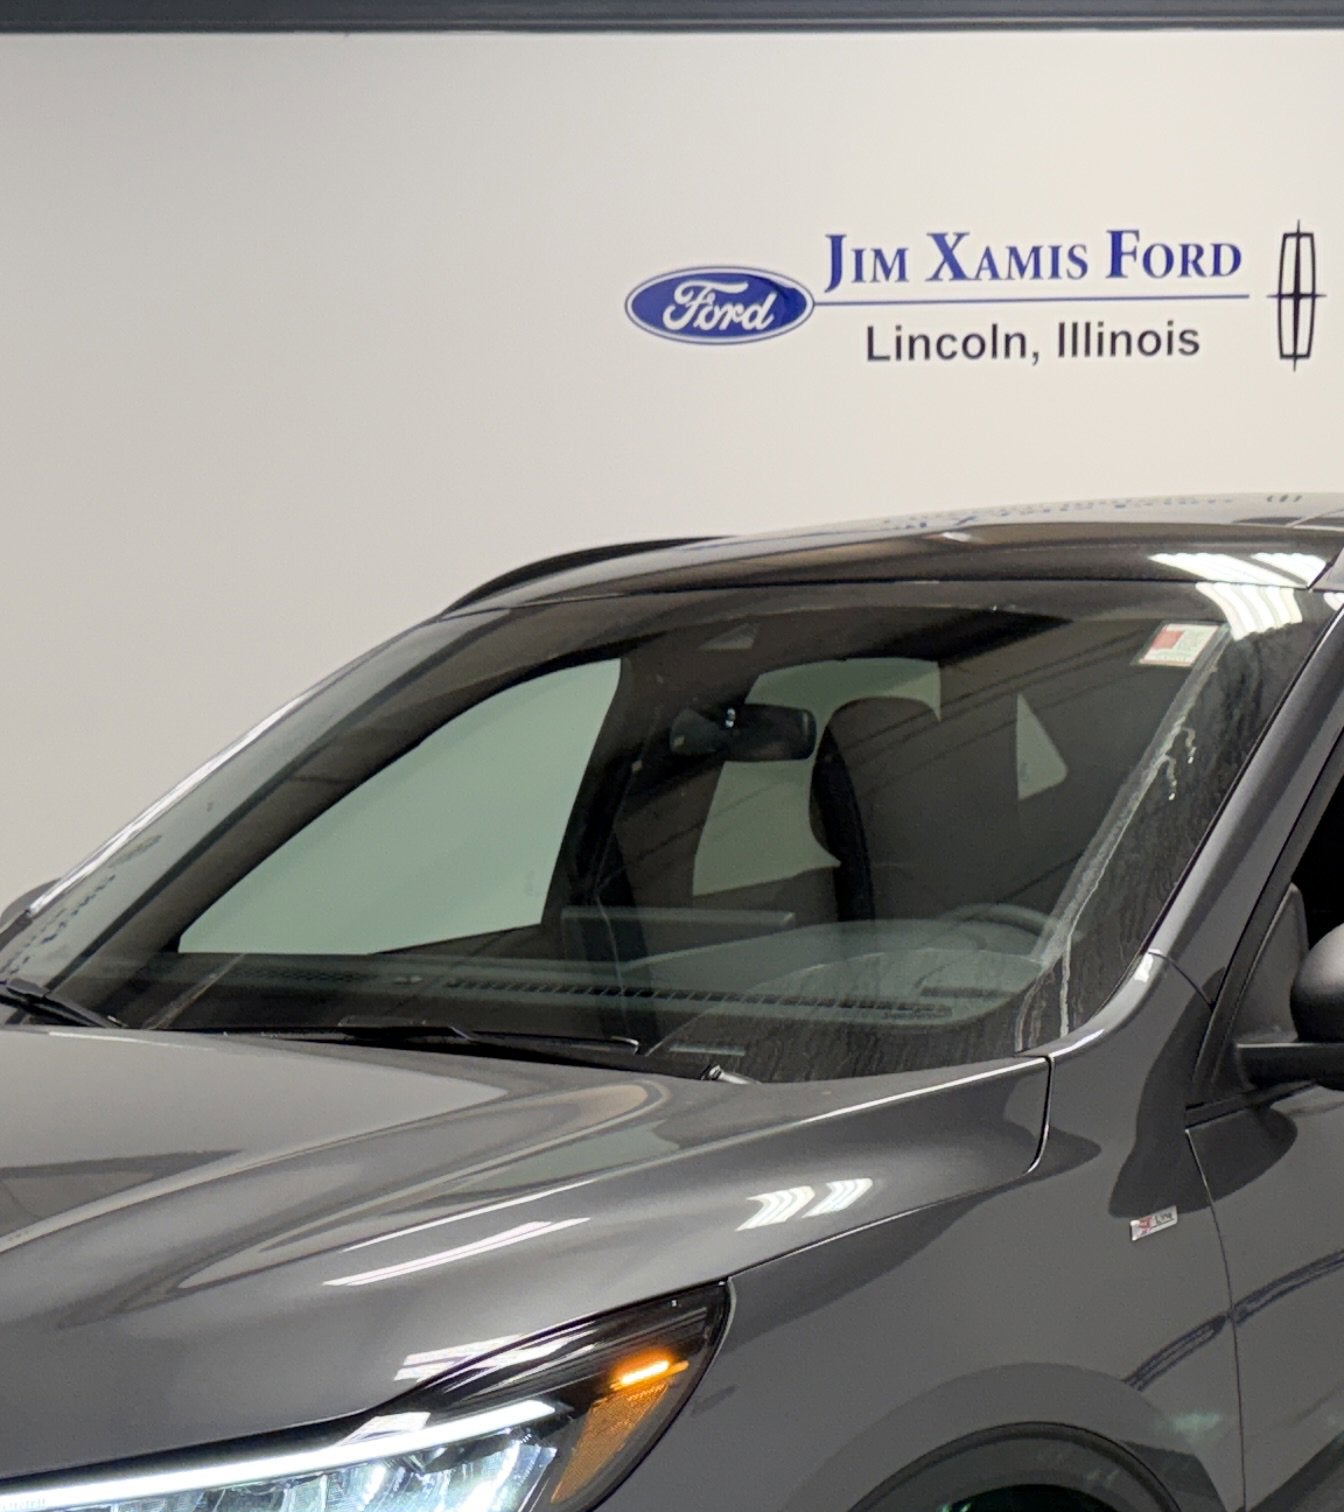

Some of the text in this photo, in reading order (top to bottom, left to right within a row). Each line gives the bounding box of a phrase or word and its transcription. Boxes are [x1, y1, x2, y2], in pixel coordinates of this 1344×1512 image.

[824, 229, 1243, 293] JIM XAMIS FORD
[662, 280, 778, 330] Ford
[866, 320, 1200, 366] Lincoln, Illinois
